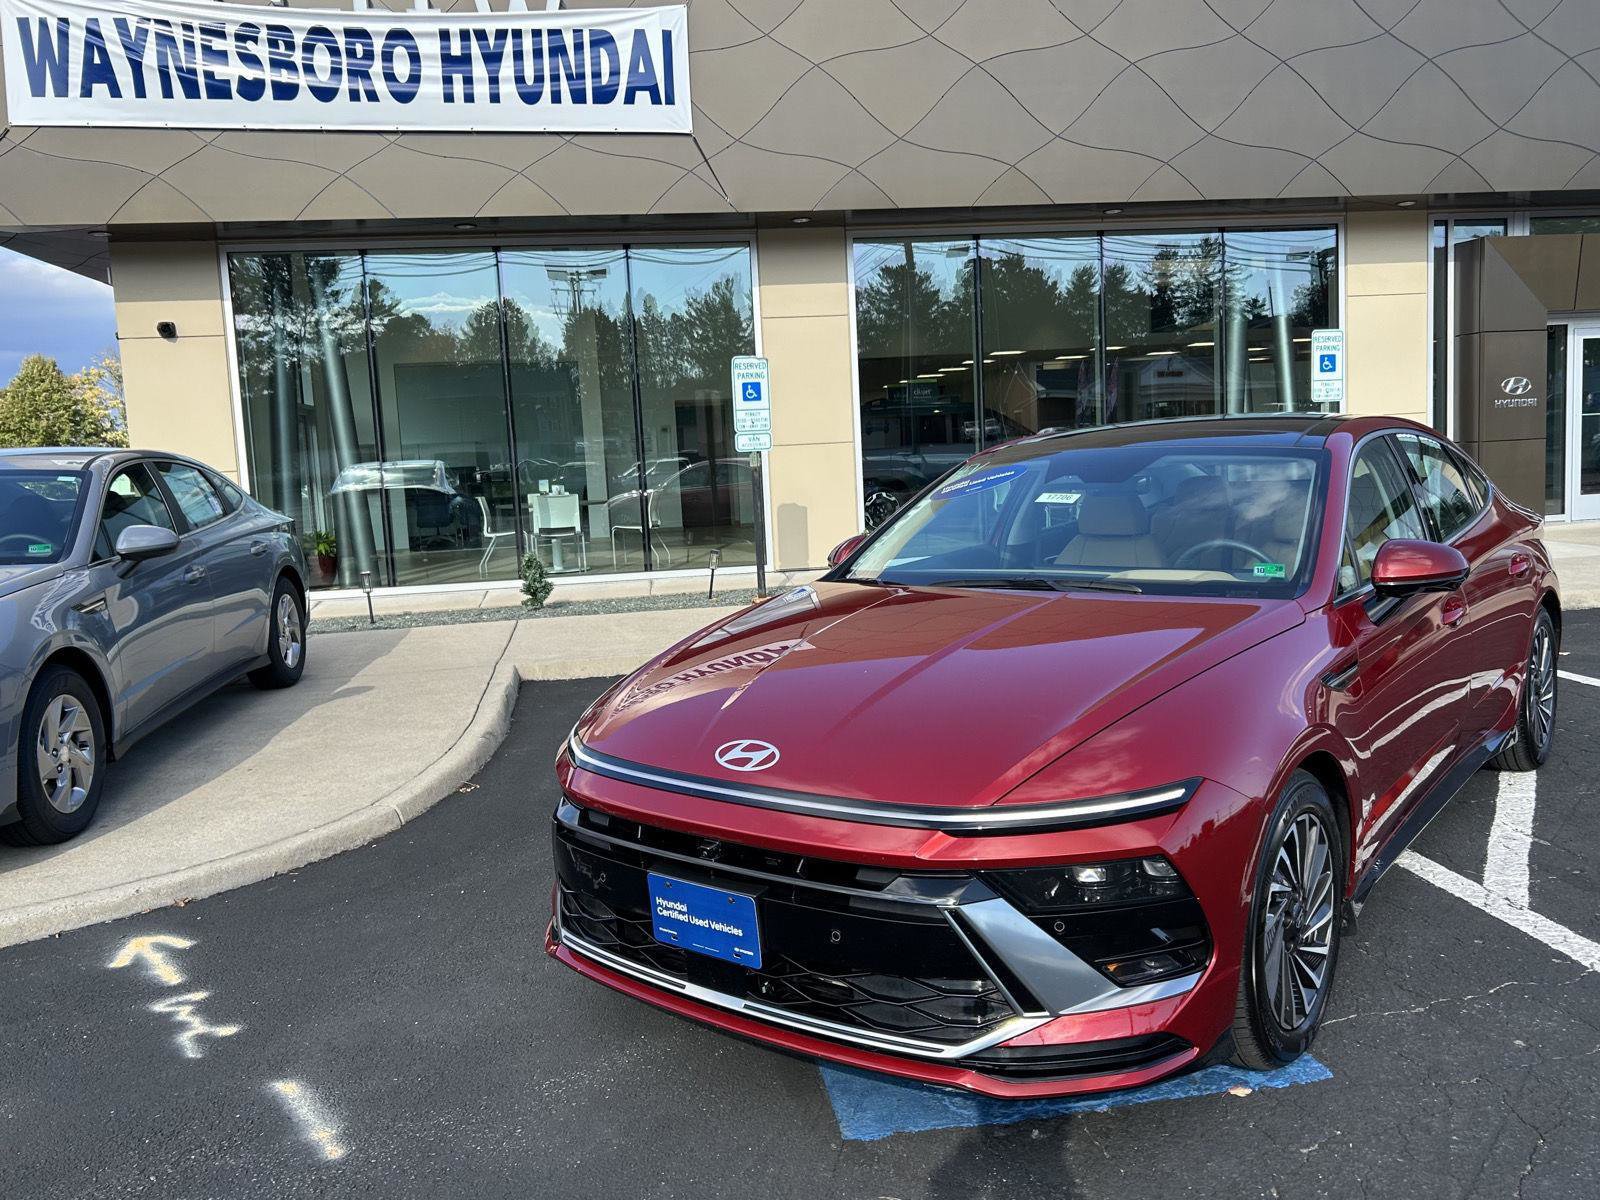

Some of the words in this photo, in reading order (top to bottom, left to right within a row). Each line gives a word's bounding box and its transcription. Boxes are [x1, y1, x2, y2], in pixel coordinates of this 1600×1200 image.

[16, 16, 422, 105] WAYNESBORO
[440, 27, 676, 106] HYUNDAI
[1313, 335, 1341, 343] RESERVED
[734, 362, 767, 371] RESERVED
[737, 372, 765, 380] PARKING
[1494, 398, 1537, 408] HYUNDAI
[656, 897, 688, 912] Hyundai
[656, 906, 689, 923] Certified
[689, 914, 710, 928] Used
[709, 920, 744, 937] Vehicles
